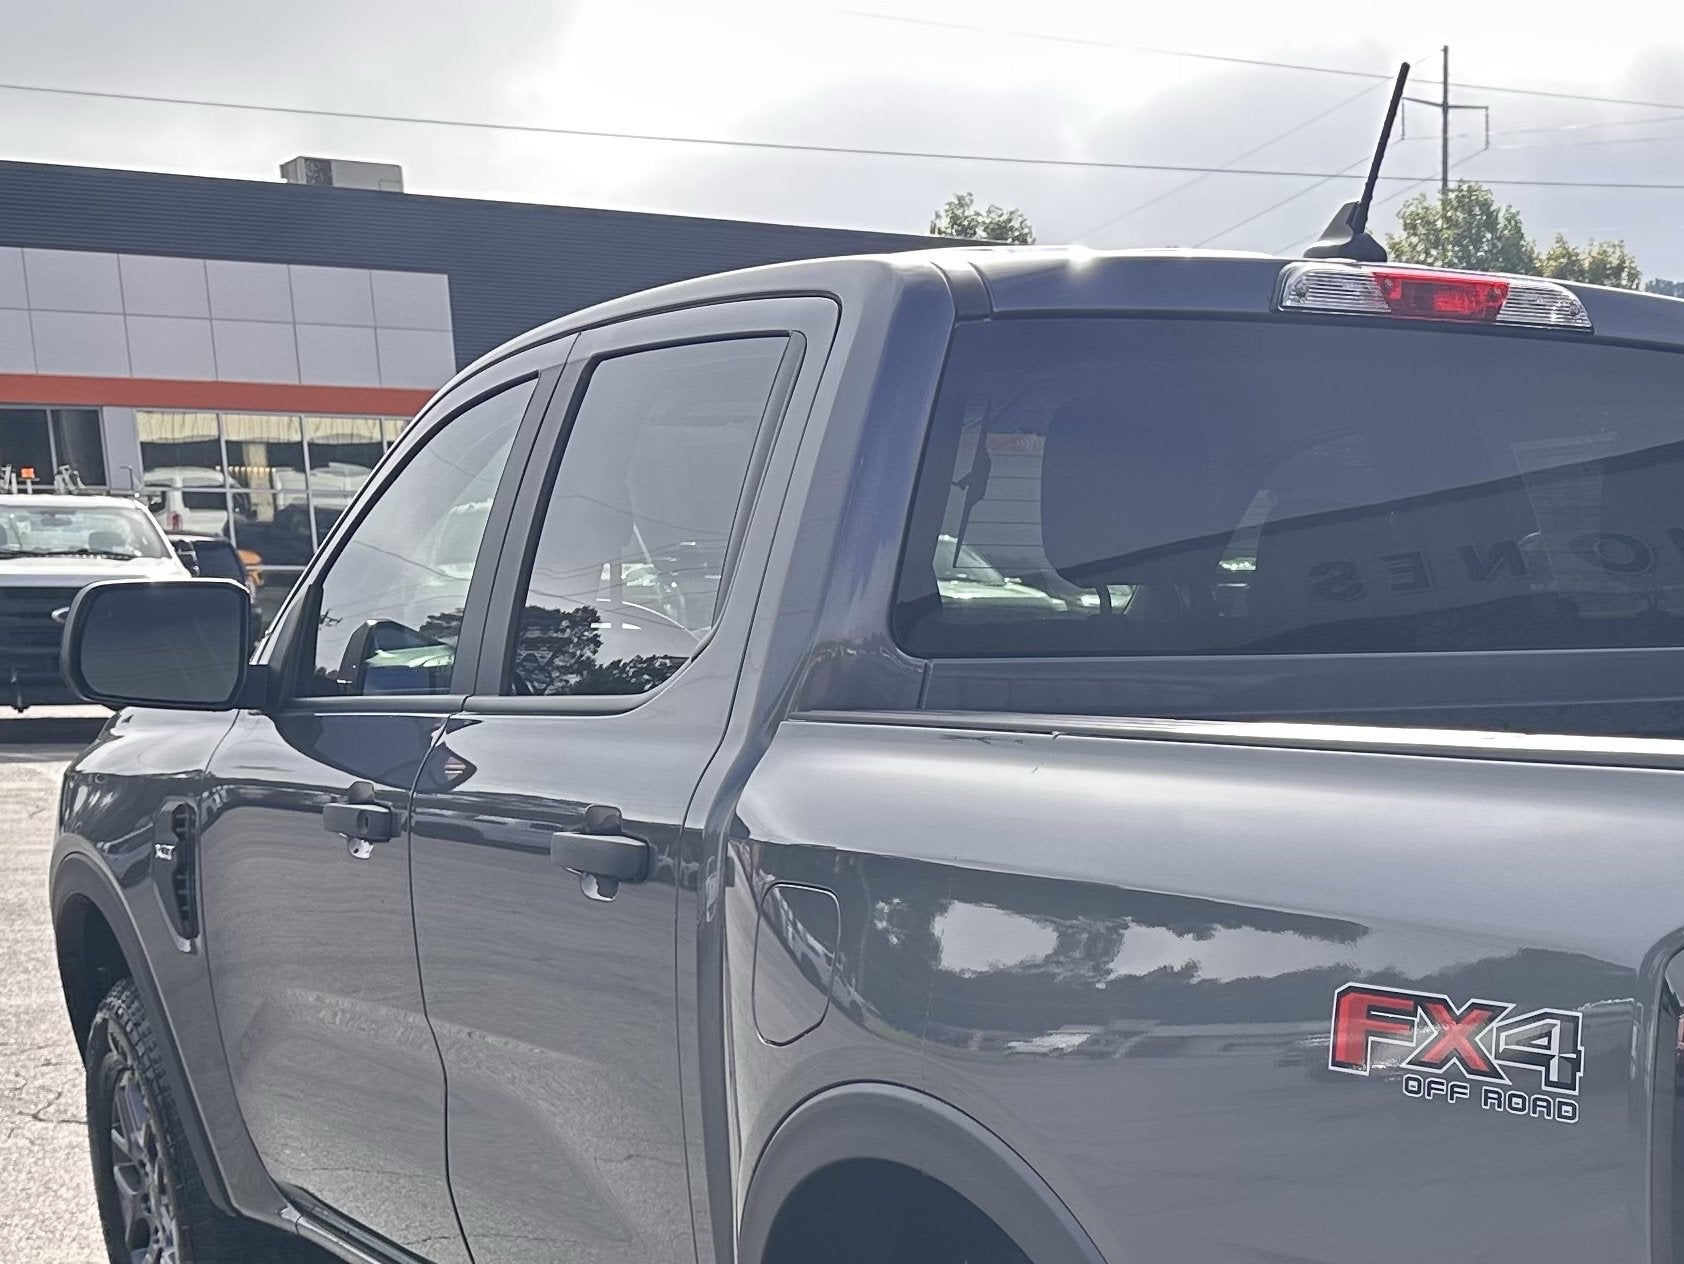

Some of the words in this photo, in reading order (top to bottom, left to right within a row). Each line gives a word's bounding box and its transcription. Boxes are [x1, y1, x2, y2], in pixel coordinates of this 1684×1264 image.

[1328, 981, 1585, 1096] FX4
[1402, 1073, 1470, 1104] OFF
[1481, 1086, 1580, 1124] ROAD
